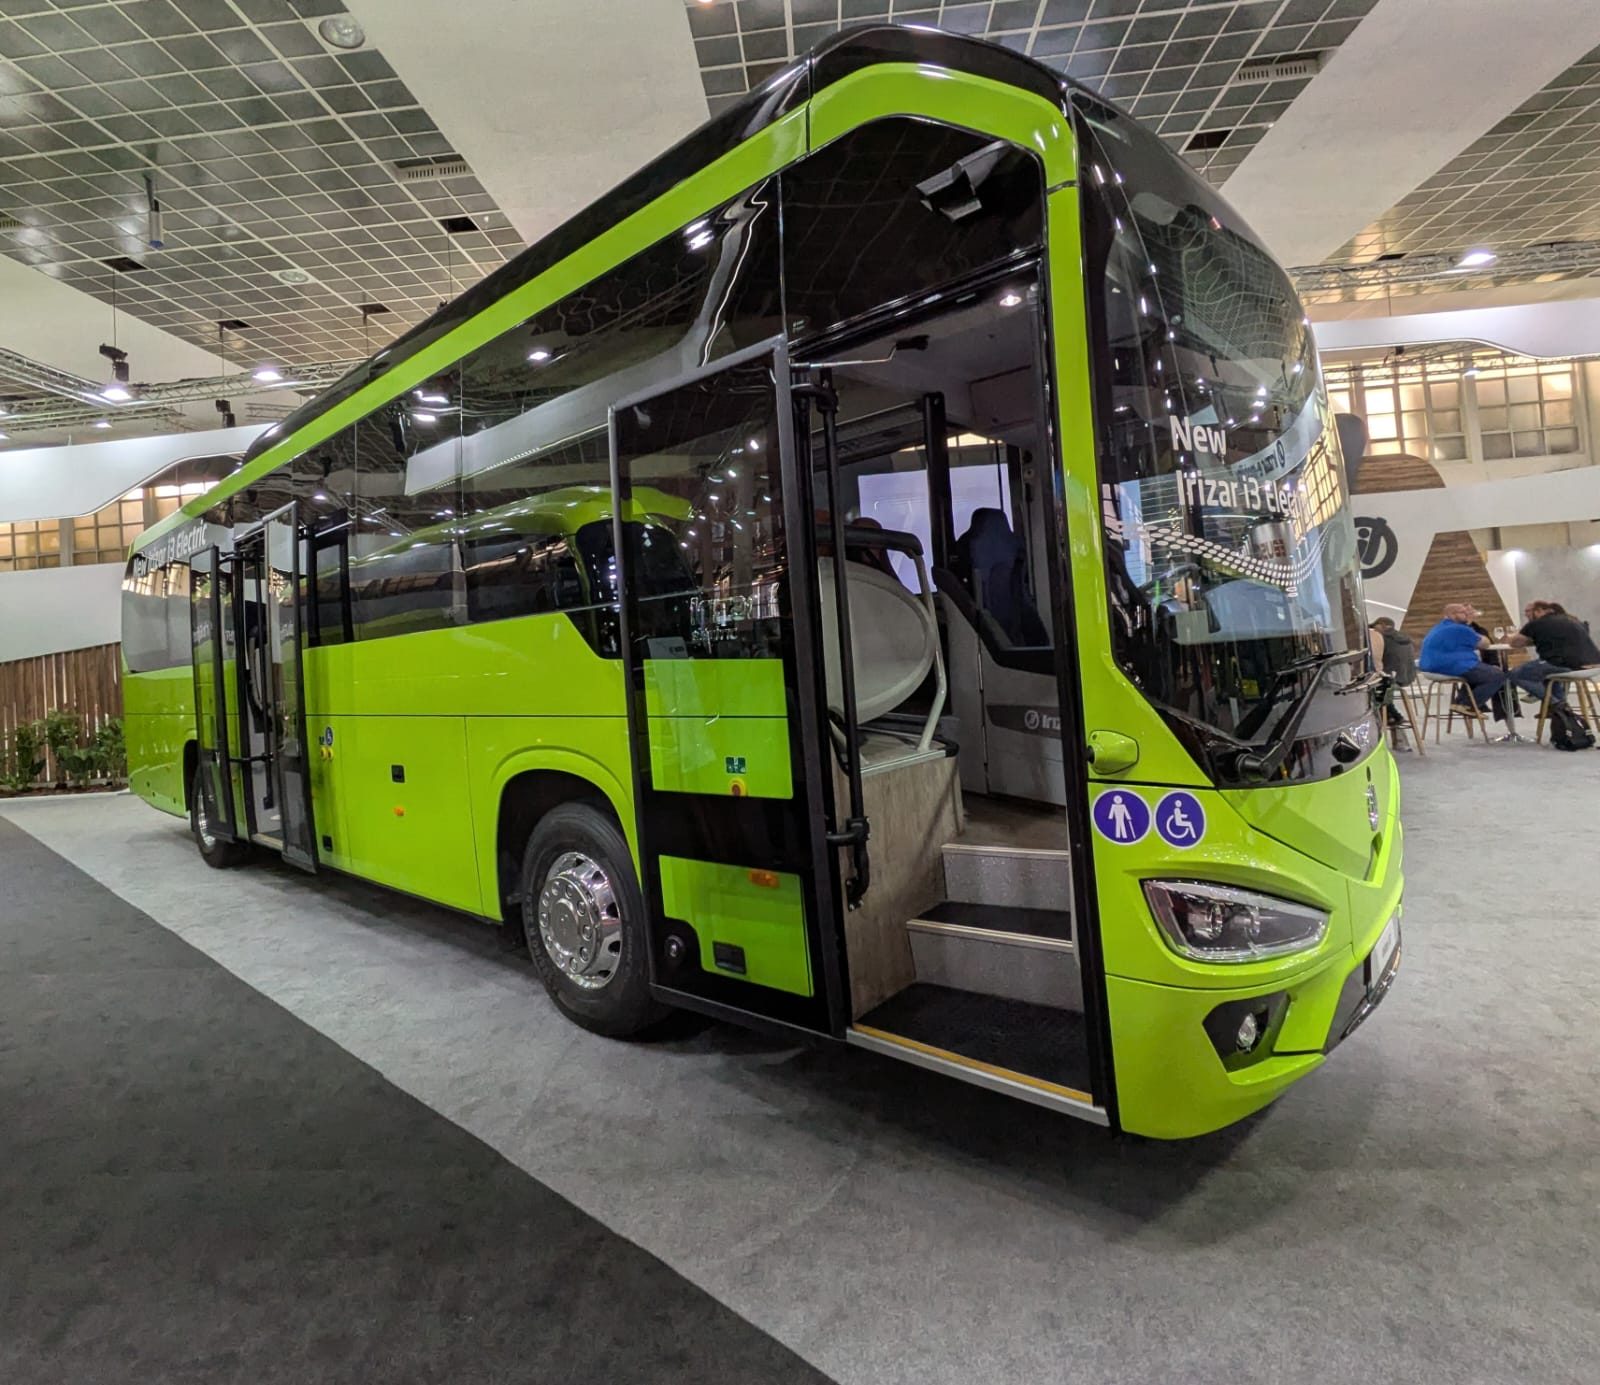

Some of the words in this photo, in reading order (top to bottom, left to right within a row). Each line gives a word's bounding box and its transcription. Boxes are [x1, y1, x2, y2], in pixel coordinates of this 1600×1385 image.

[1169, 415, 1227, 455] New
[1176, 469, 1238, 507] Irizar
[1243, 475, 1262, 510] i3
[176, 519, 208, 559] Electric
